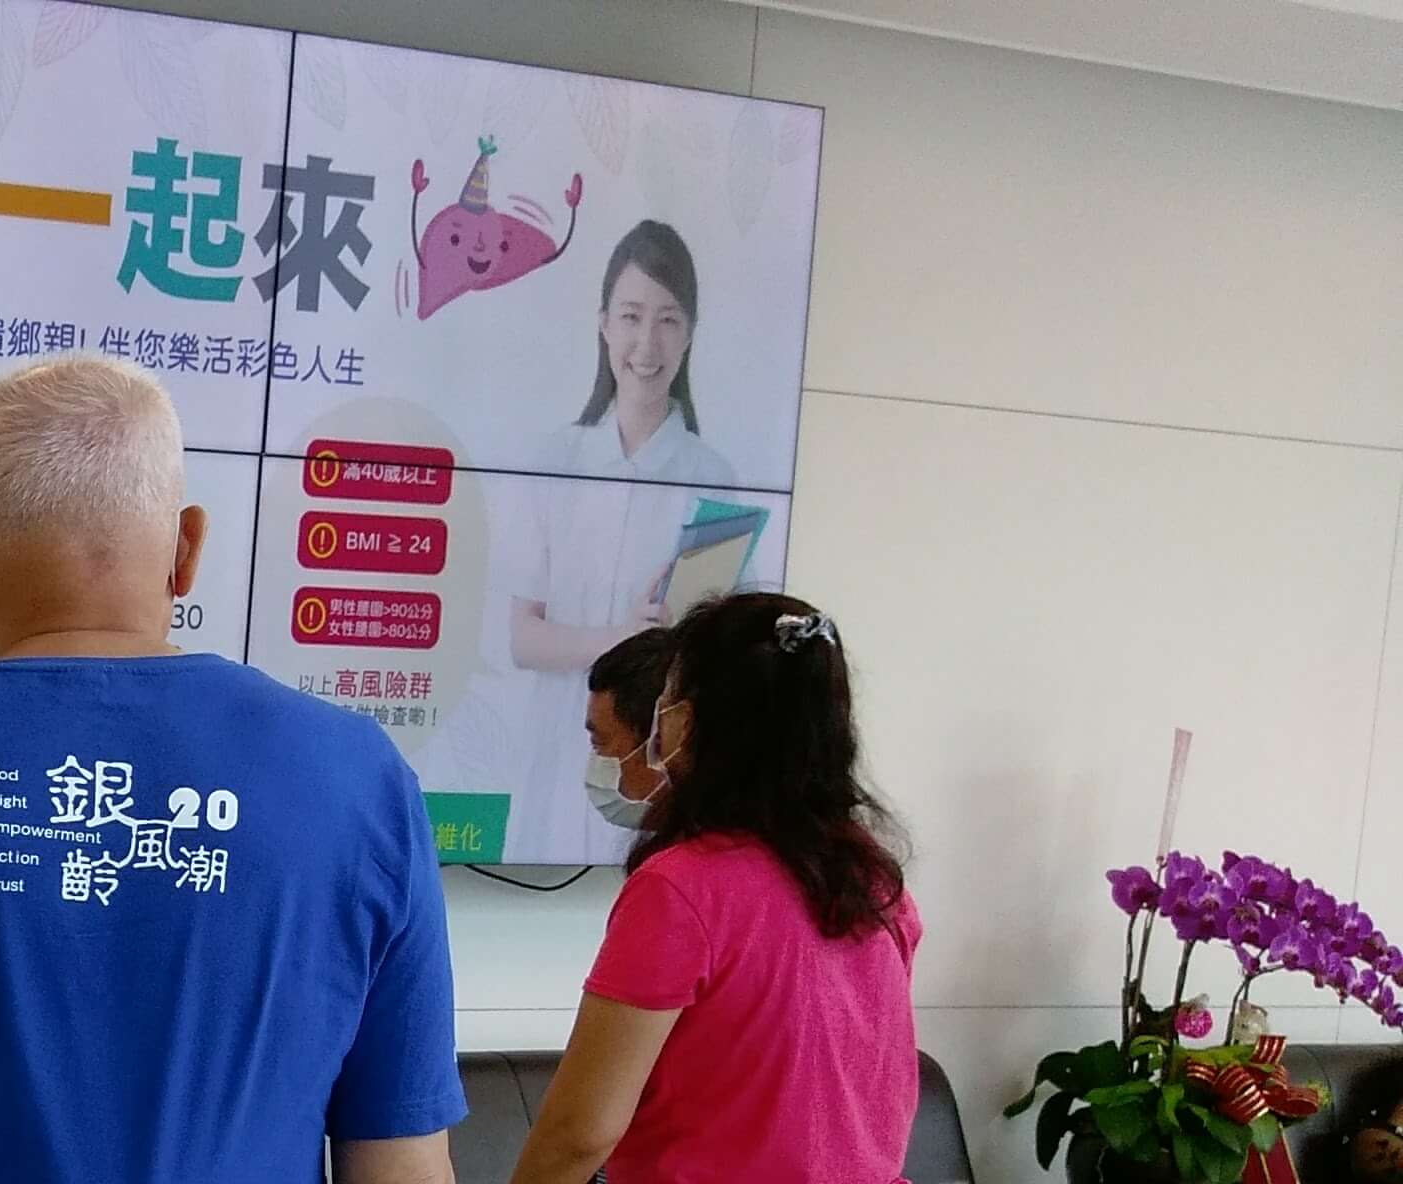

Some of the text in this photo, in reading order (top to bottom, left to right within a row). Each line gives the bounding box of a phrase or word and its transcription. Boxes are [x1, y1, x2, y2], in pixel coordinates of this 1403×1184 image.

[346, 531, 381, 552] BMI
[409, 535, 431, 553] 24
[171, 604, 203, 630] 30
[299, 669, 433, 700] 以上高風險群
[168, 787, 238, 831] 20
